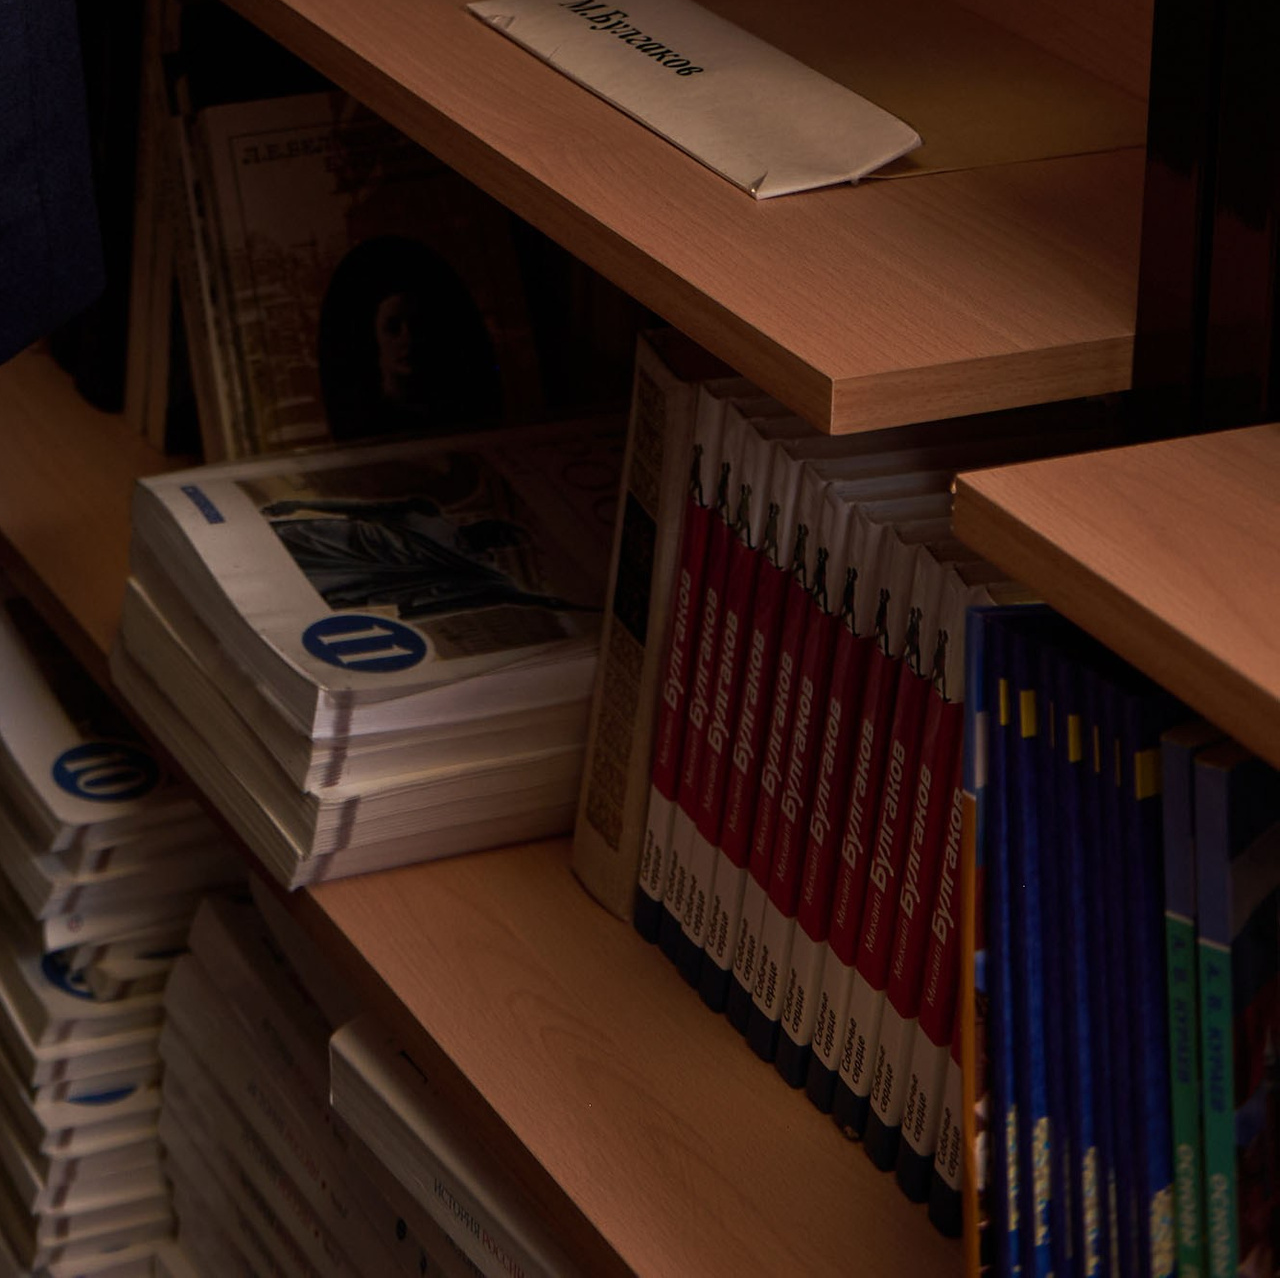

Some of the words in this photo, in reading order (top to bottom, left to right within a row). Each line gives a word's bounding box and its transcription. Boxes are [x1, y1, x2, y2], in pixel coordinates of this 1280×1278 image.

[317, 624, 414, 665] 11
[664, 568, 691, 711] Булгаков
[689, 587, 718, 730] Булгаков
[707, 610, 739, 755] Булгаков
[733, 629, 765, 775] Булгаков
[761, 651, 793, 799] Булгаков
[781, 676, 814, 823] Булгаков
[64, 754, 144, 791] 10
[810, 697, 842, 846] Булгаков
[842, 718, 874, 870] Булгаков
[870, 739, 906, 893] Булгаков
[900, 763, 932, 919] Булгаков
[931, 786, 963, 944] Булгаков
[837, 868, 854, 929] Михаил
[864, 892, 882, 953] Михаил
[755, 945, 769, 998] Собачье
[893, 918, 910, 980] Михаил
[925, 944, 943, 1007] Михаил
[765, 961, 778, 1009] сердце
[783, 968, 797, 1023] Собачье
[792, 985, 805, 1034] сердце
[814, 992, 829, 1046] Собачье
[823, 1009, 836, 1058] сердце
[843, 1017, 857, 1073] Собачье
[852, 1035, 865, 1085] сердце
[872, 1045, 885, 1102] Собачье
[880, 1063, 893, 1114] сердце
[904, 1073, 918, 1130] Собачье
[914, 1092, 927, 1143] сердце
[937, 1107, 951, 1165] Собачье
[948, 1126, 961, 1178] сердце
